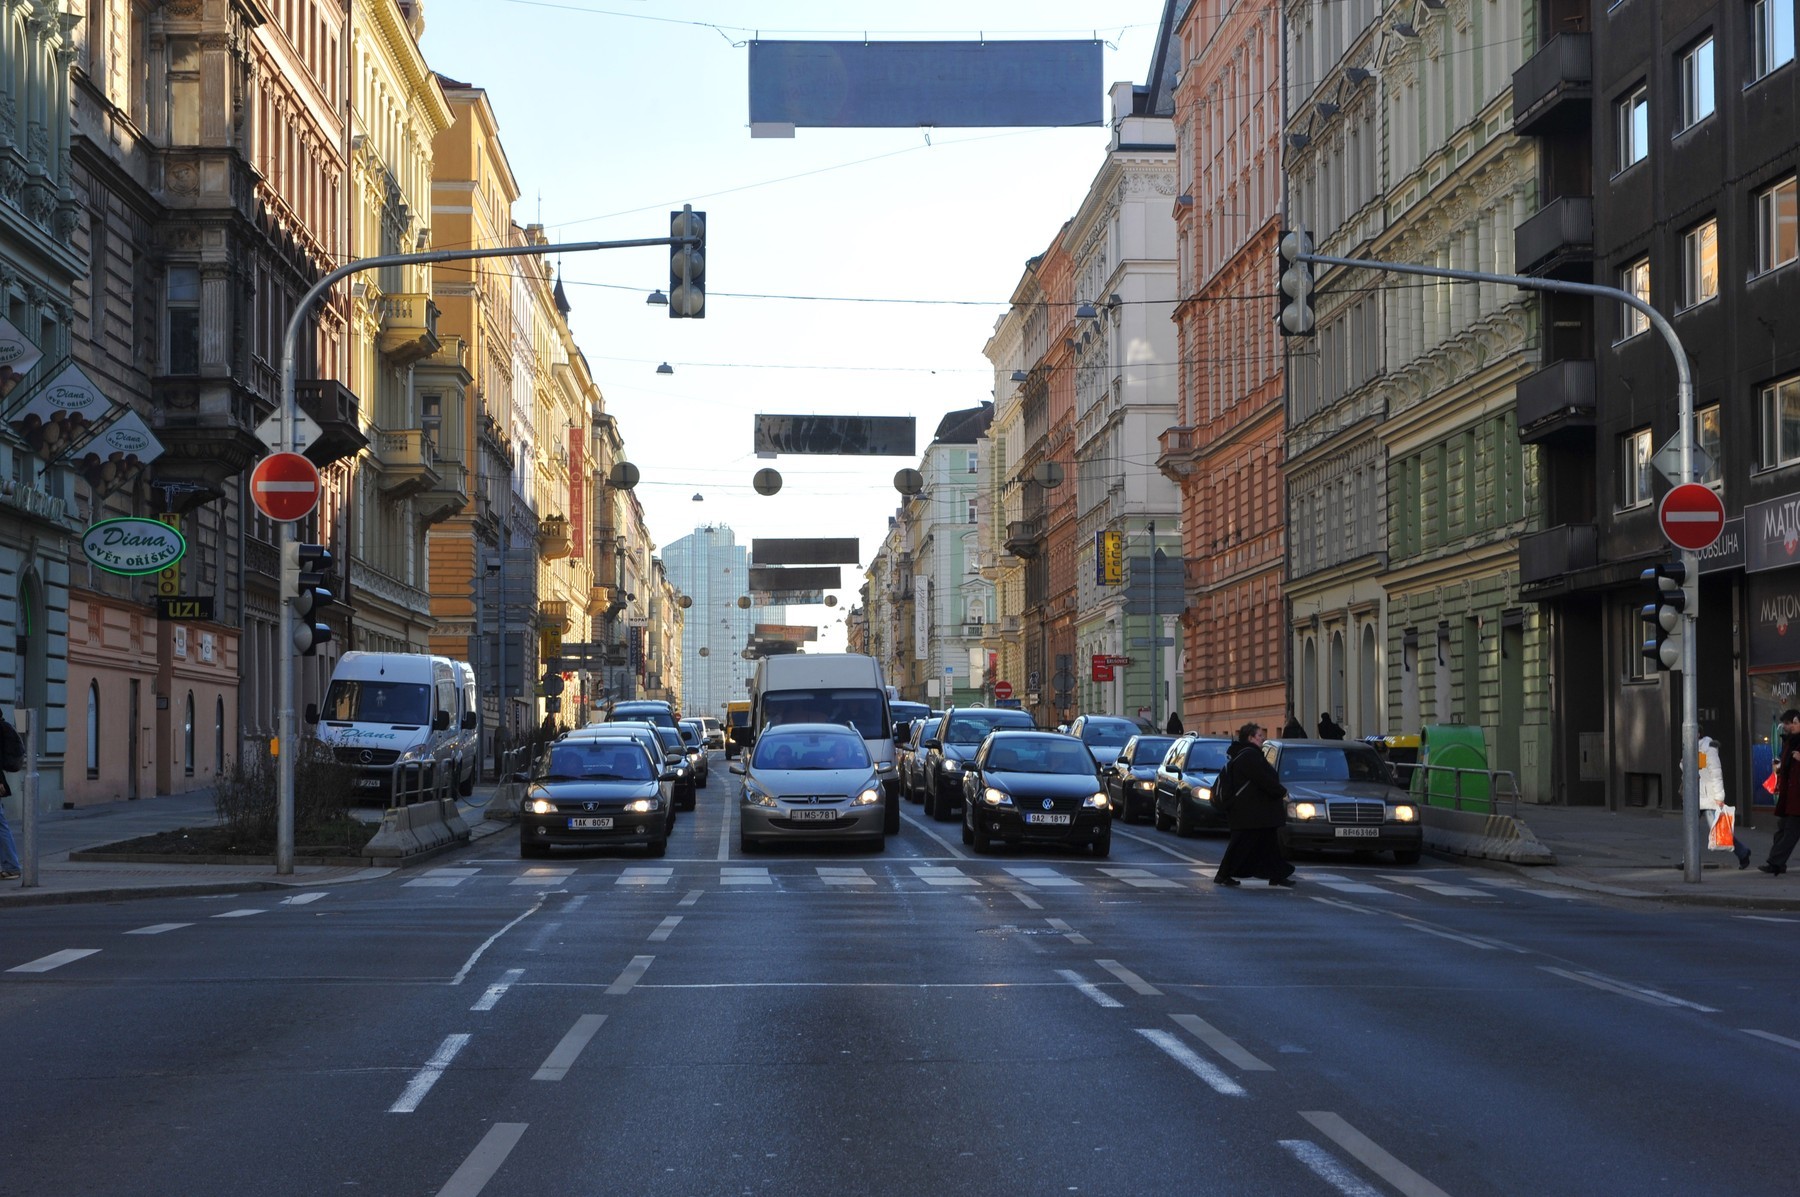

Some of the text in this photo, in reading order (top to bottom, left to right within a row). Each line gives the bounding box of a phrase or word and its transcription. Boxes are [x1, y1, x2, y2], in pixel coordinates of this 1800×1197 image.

[56, 388, 85, 400] Diana
[115, 431, 141, 443] Diana
[102, 527, 168, 548] Diana
[88, 542, 176, 567] SVĚT OŘÍŠKŮ
[1771, 682, 1797, 697] MATTONI
[341, 728, 397, 740] Diana
[574, 819, 610, 827] 1AK 8057
[1050, 815, 1067, 823] 1817
